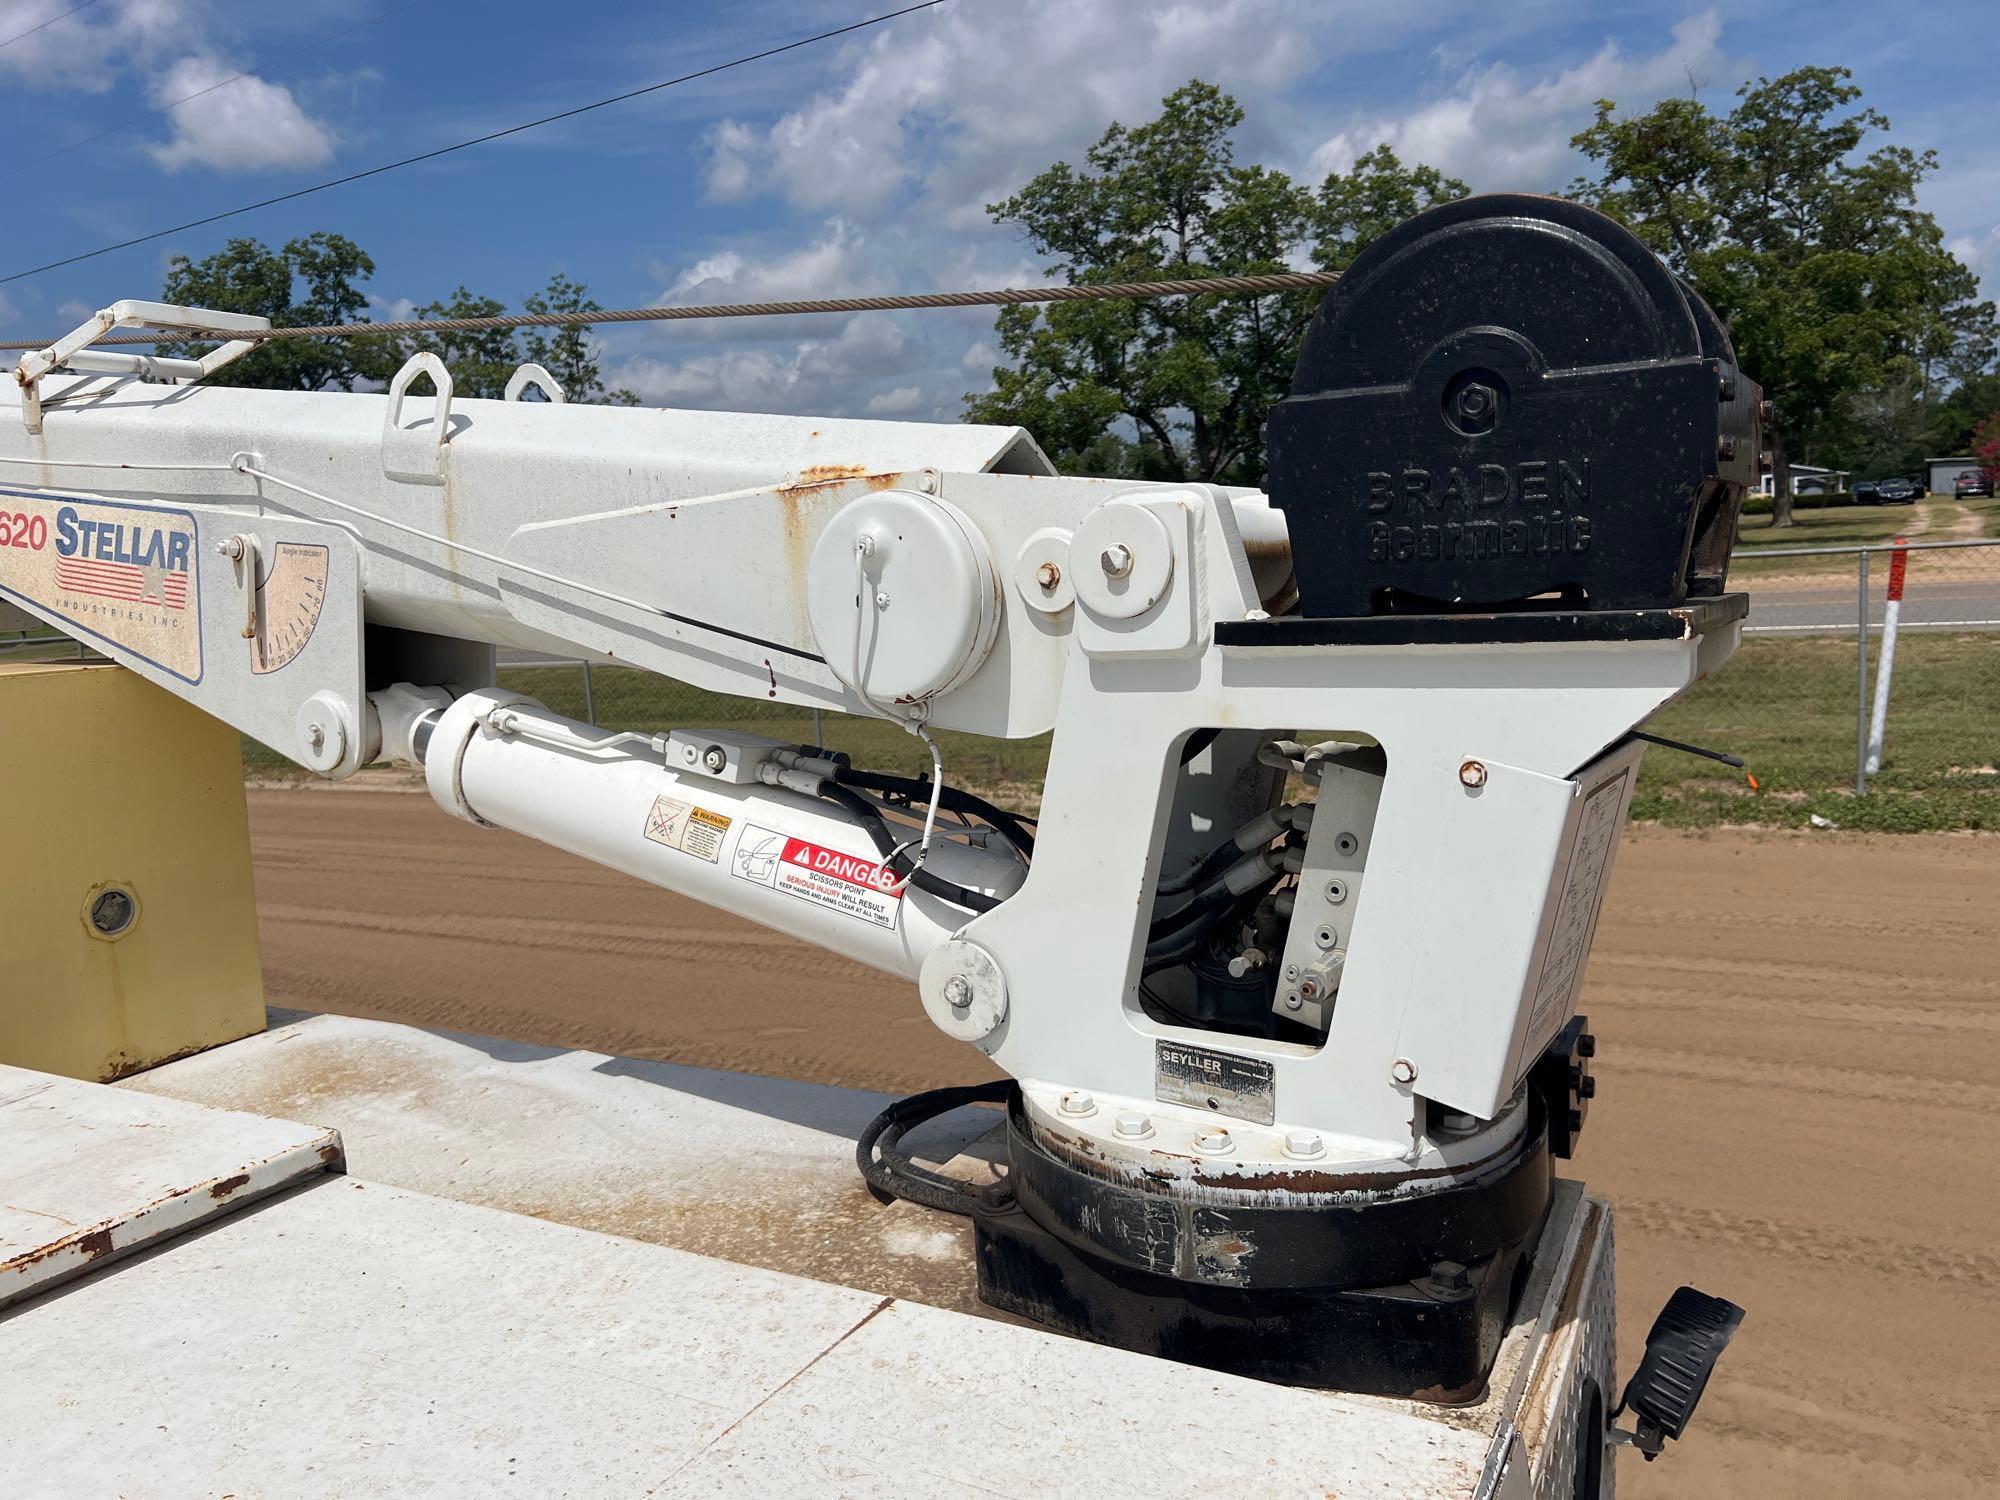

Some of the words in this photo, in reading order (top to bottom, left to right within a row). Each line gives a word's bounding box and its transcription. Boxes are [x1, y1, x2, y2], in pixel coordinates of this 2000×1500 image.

[1367, 457, 1591, 514] BRADEN
[55, 507, 191, 572] STELLAR
[56, 599, 144, 622] INDUSTRIES
[699, 811, 730, 827] WARNING
[786, 874, 815, 890] SERIOUS
[816, 884, 840, 898] INJURY
[841, 893, 858, 905] WILL
[858, 898, 885, 913] RESULT
[809, 872, 844, 889] SCISSORS
[845, 883, 866, 896] POINT
[779, 881, 793, 890] KEEP
[793, 885, 811, 896] HANDS
[811, 891, 822, 900] AND
[822, 895, 837, 905] ARMS
[838, 901, 855, 912] CLEAR
[863, 909, 873, 918] ALL
[873, 913, 890, 923] TIMES
[1162, 1050, 1222, 1072] SEYLLER
